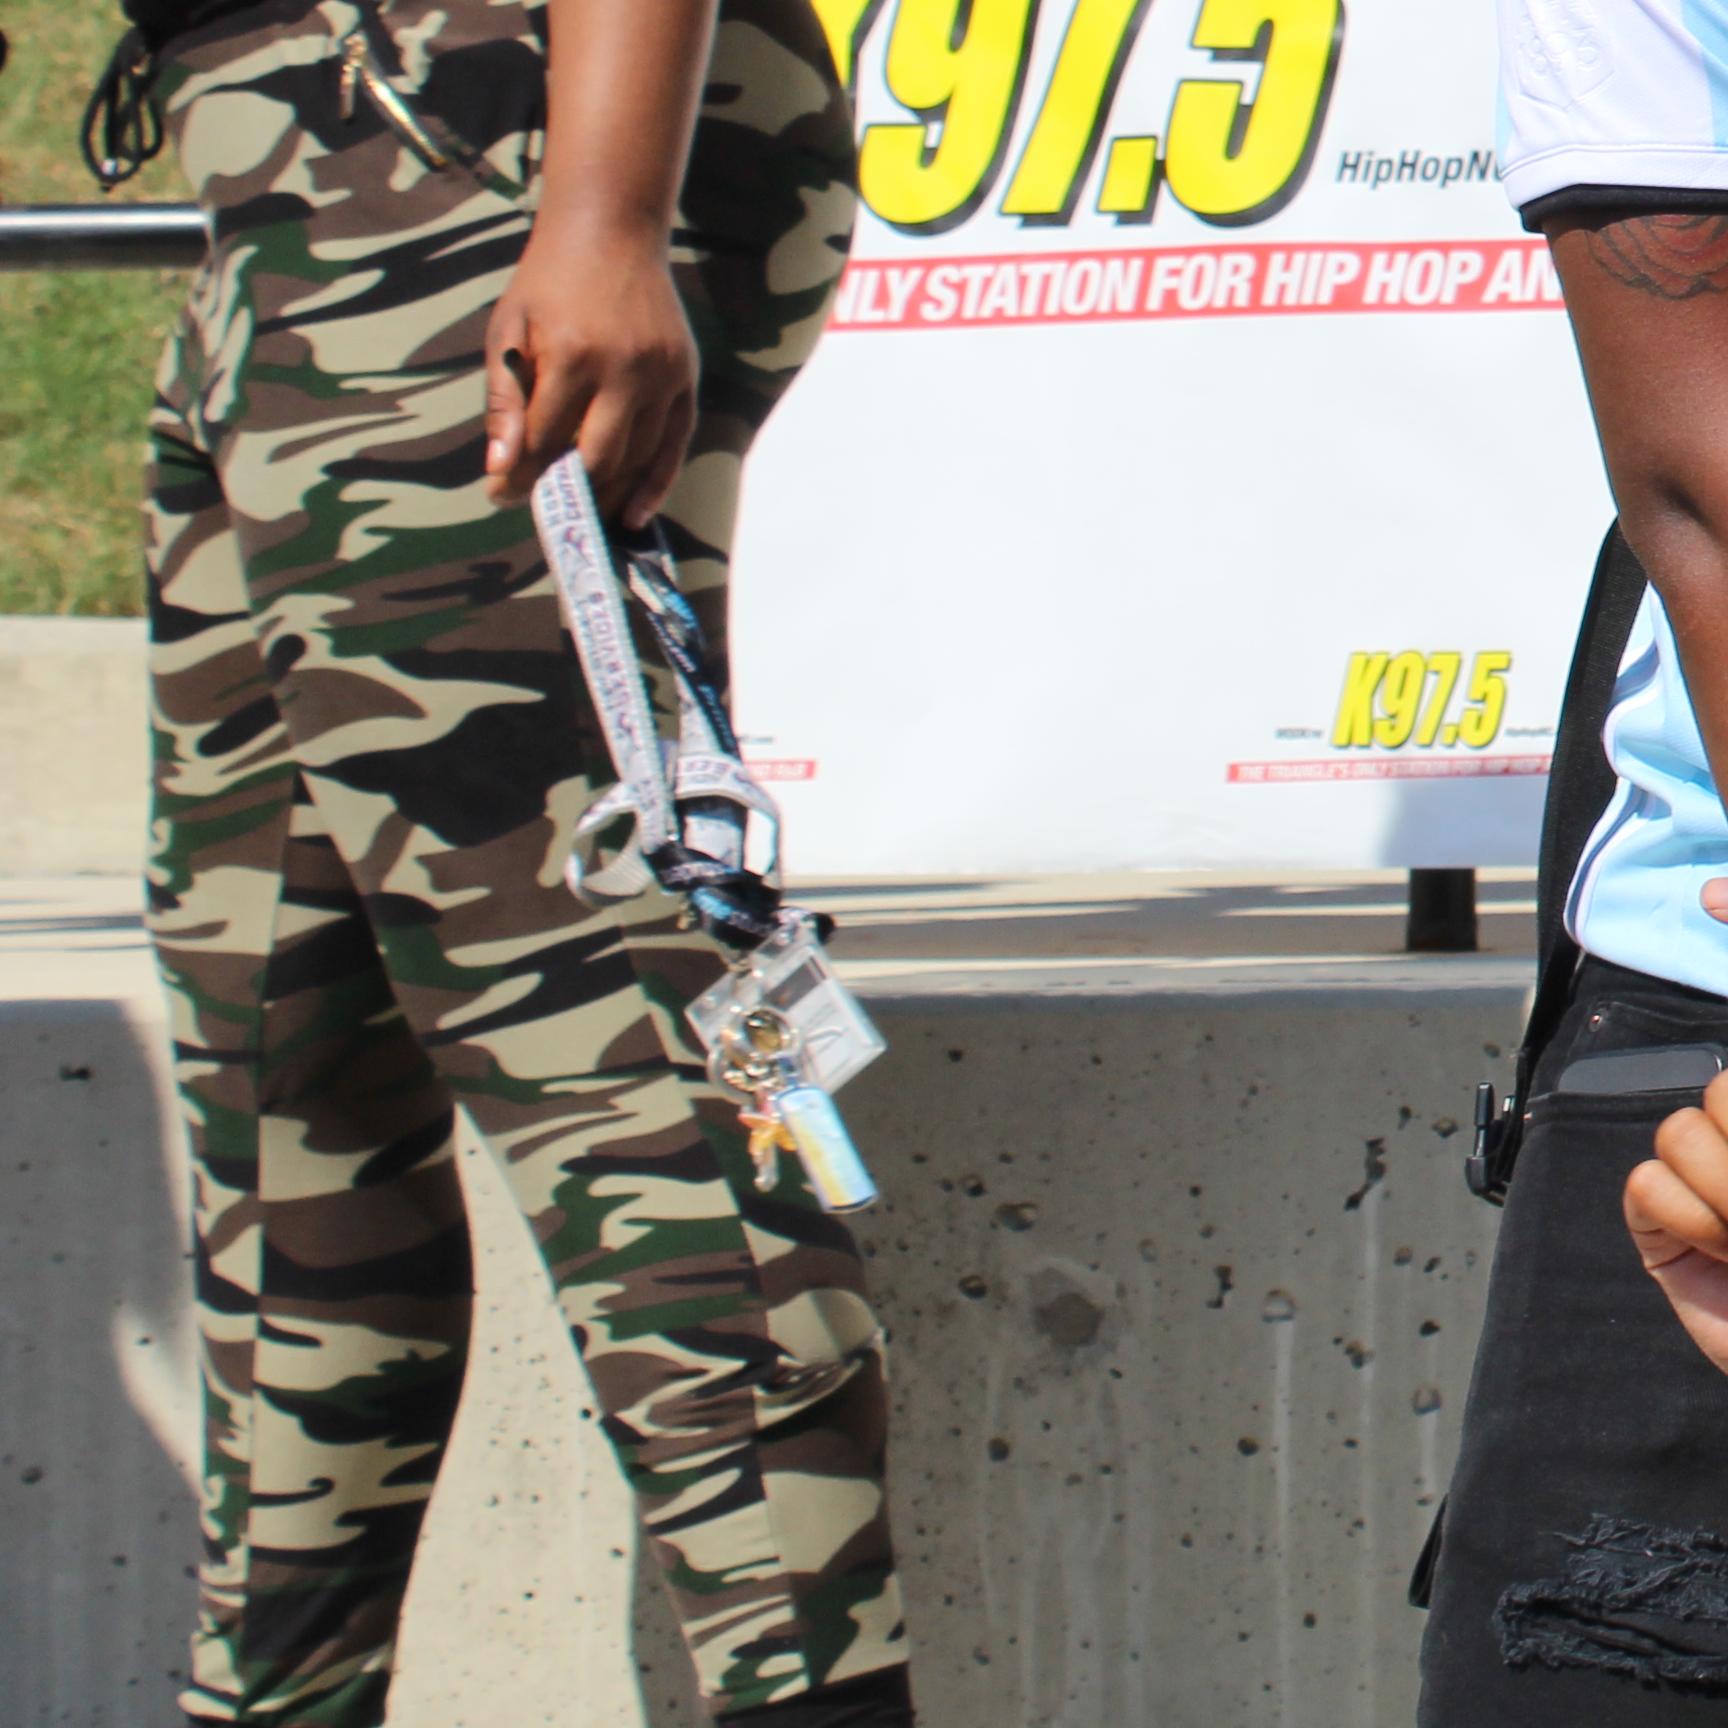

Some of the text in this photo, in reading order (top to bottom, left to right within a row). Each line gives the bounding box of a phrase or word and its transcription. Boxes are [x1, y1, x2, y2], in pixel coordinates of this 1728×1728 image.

[834, 248, 1564, 323] NLY STATION FOR HIP HOP AN
[1329, 649, 1512, 750] K97.5
